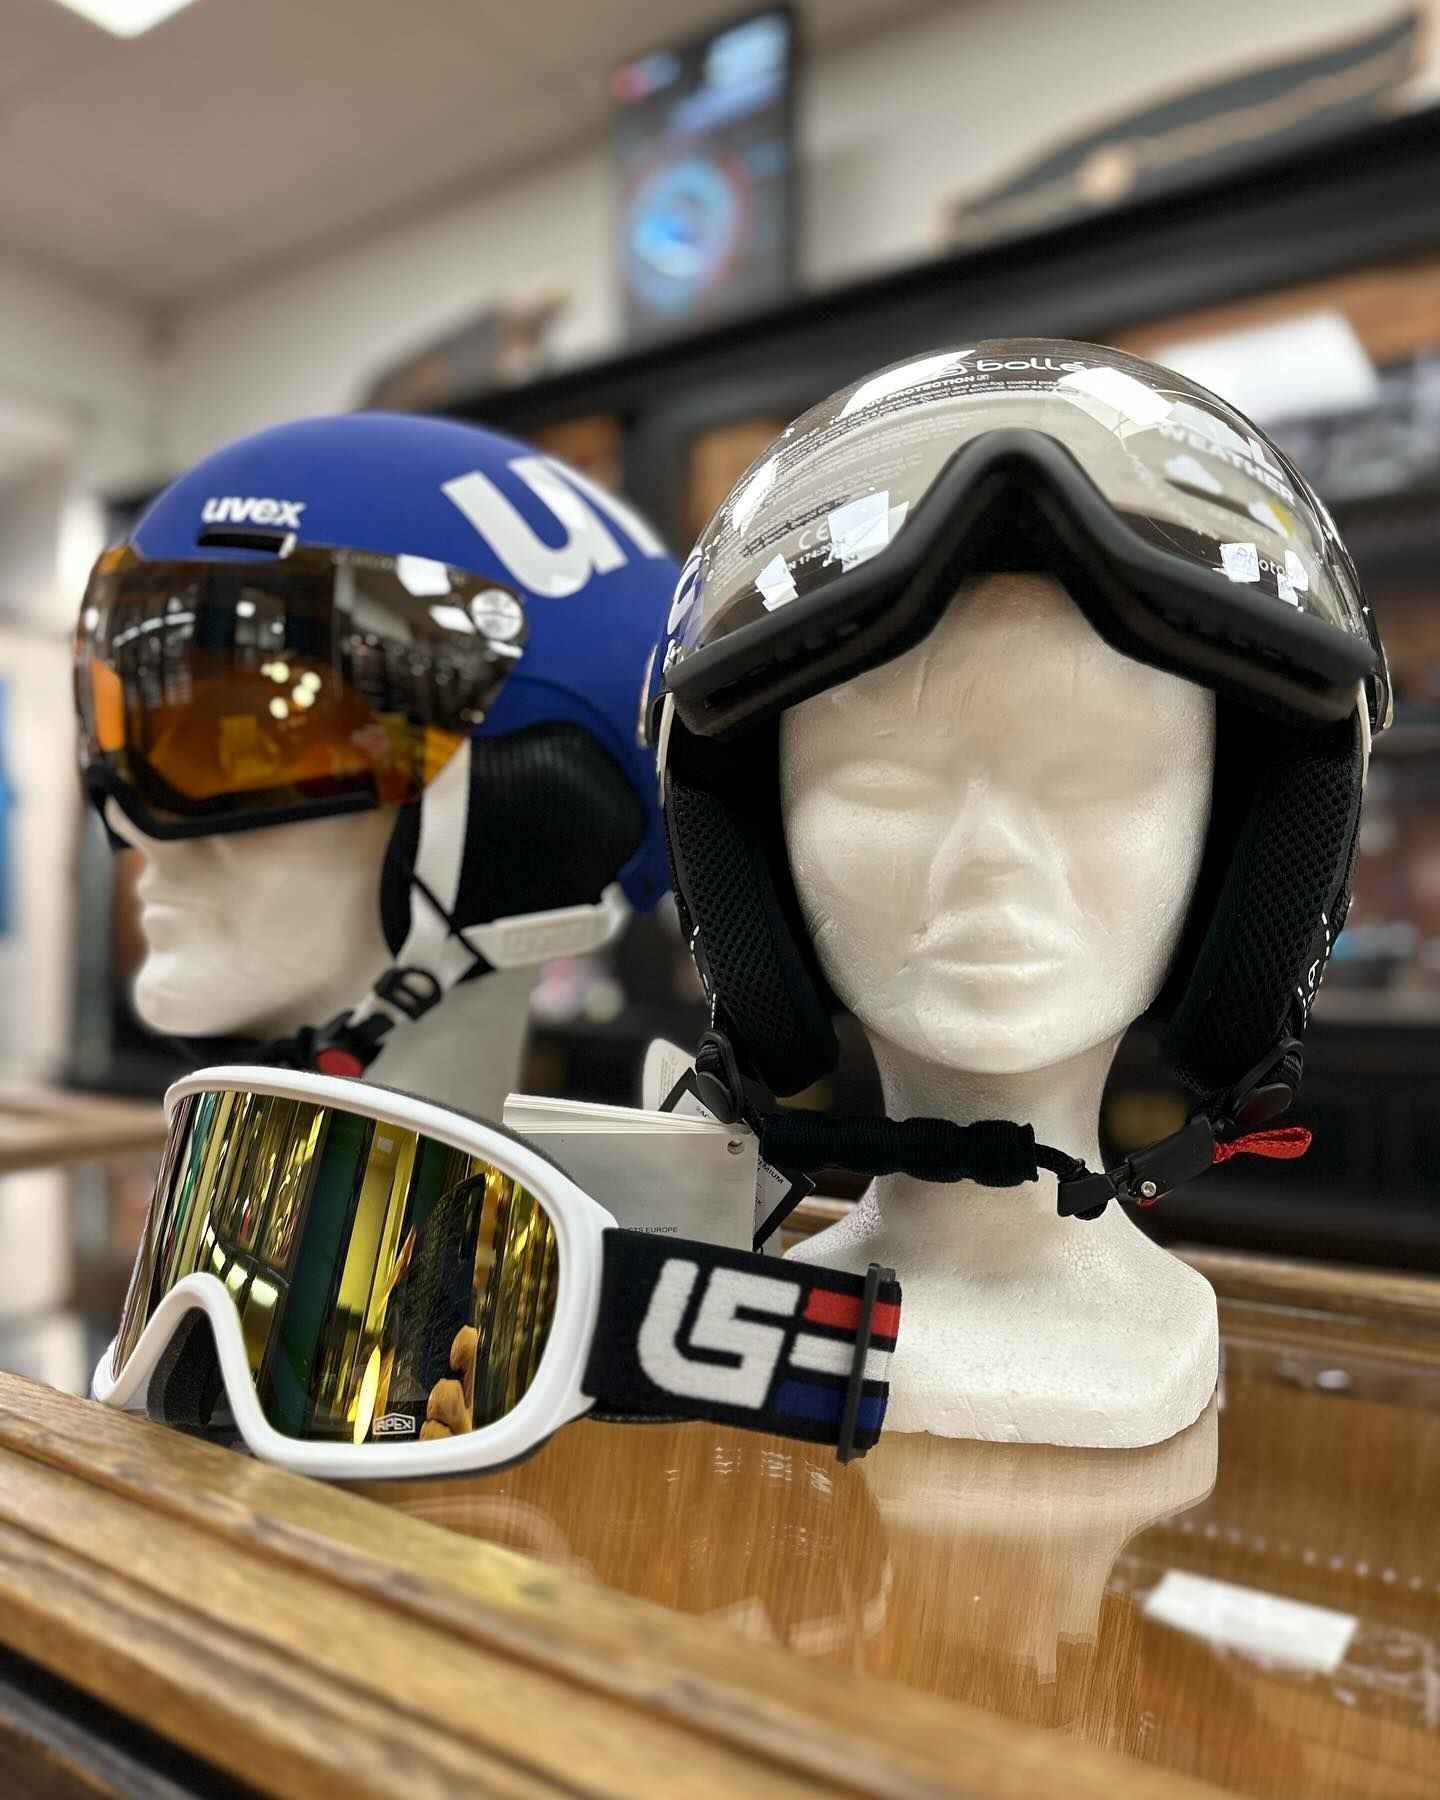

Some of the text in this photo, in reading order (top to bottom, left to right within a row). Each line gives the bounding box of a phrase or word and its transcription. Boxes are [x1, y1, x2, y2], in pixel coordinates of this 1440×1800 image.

[887, 376, 976, 401] PROTECTION
[1157, 423, 1296, 507] WEATHER
[201, 496, 306, 530] uvex
[757, 1159, 785, 1185] EMIUM
[376, 1417, 412, 1431] APEX
